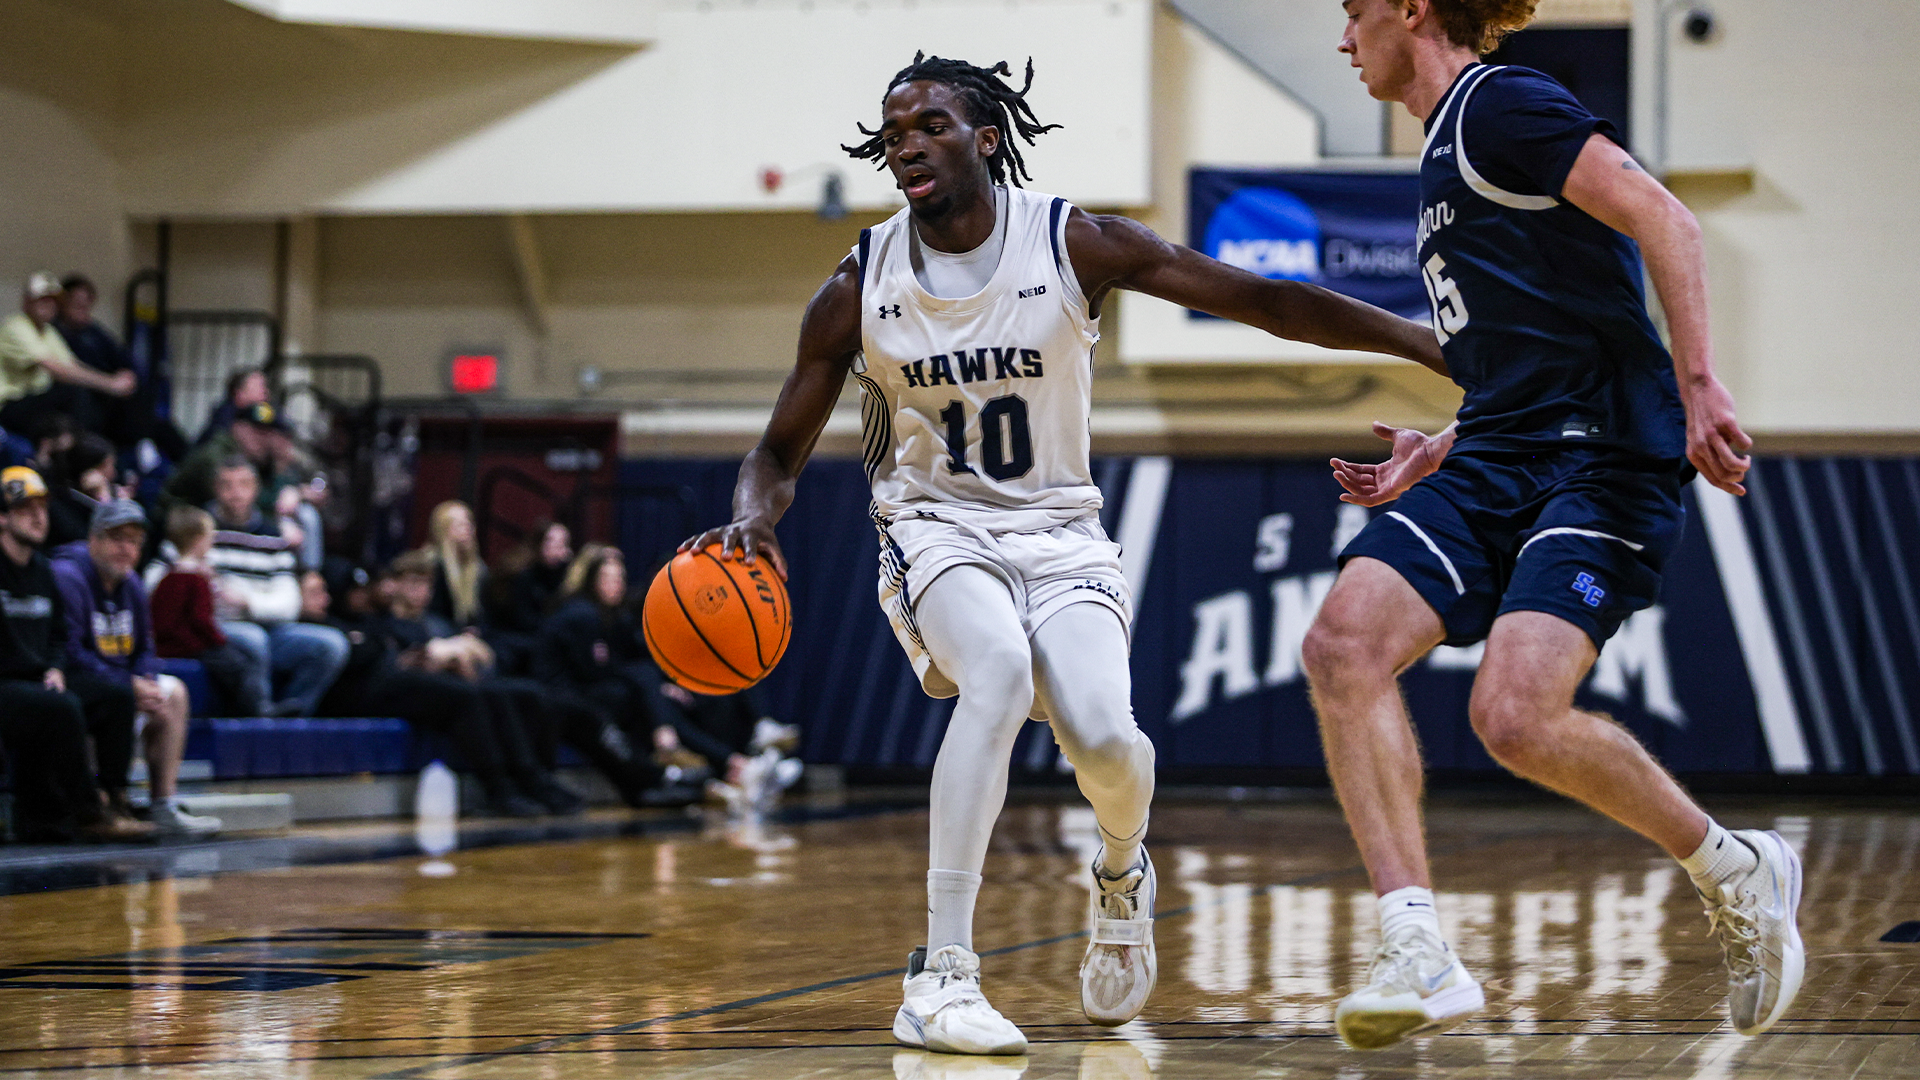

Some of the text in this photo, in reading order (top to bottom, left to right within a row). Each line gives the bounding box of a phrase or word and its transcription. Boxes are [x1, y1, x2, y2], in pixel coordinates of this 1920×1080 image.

[1018, 285, 1047, 299] NE10
[1422, 252, 1469, 346] 15
[900, 347, 1044, 388] HAWKS
[939, 393, 1035, 483] 10
[1571, 571, 1605, 607] SC
